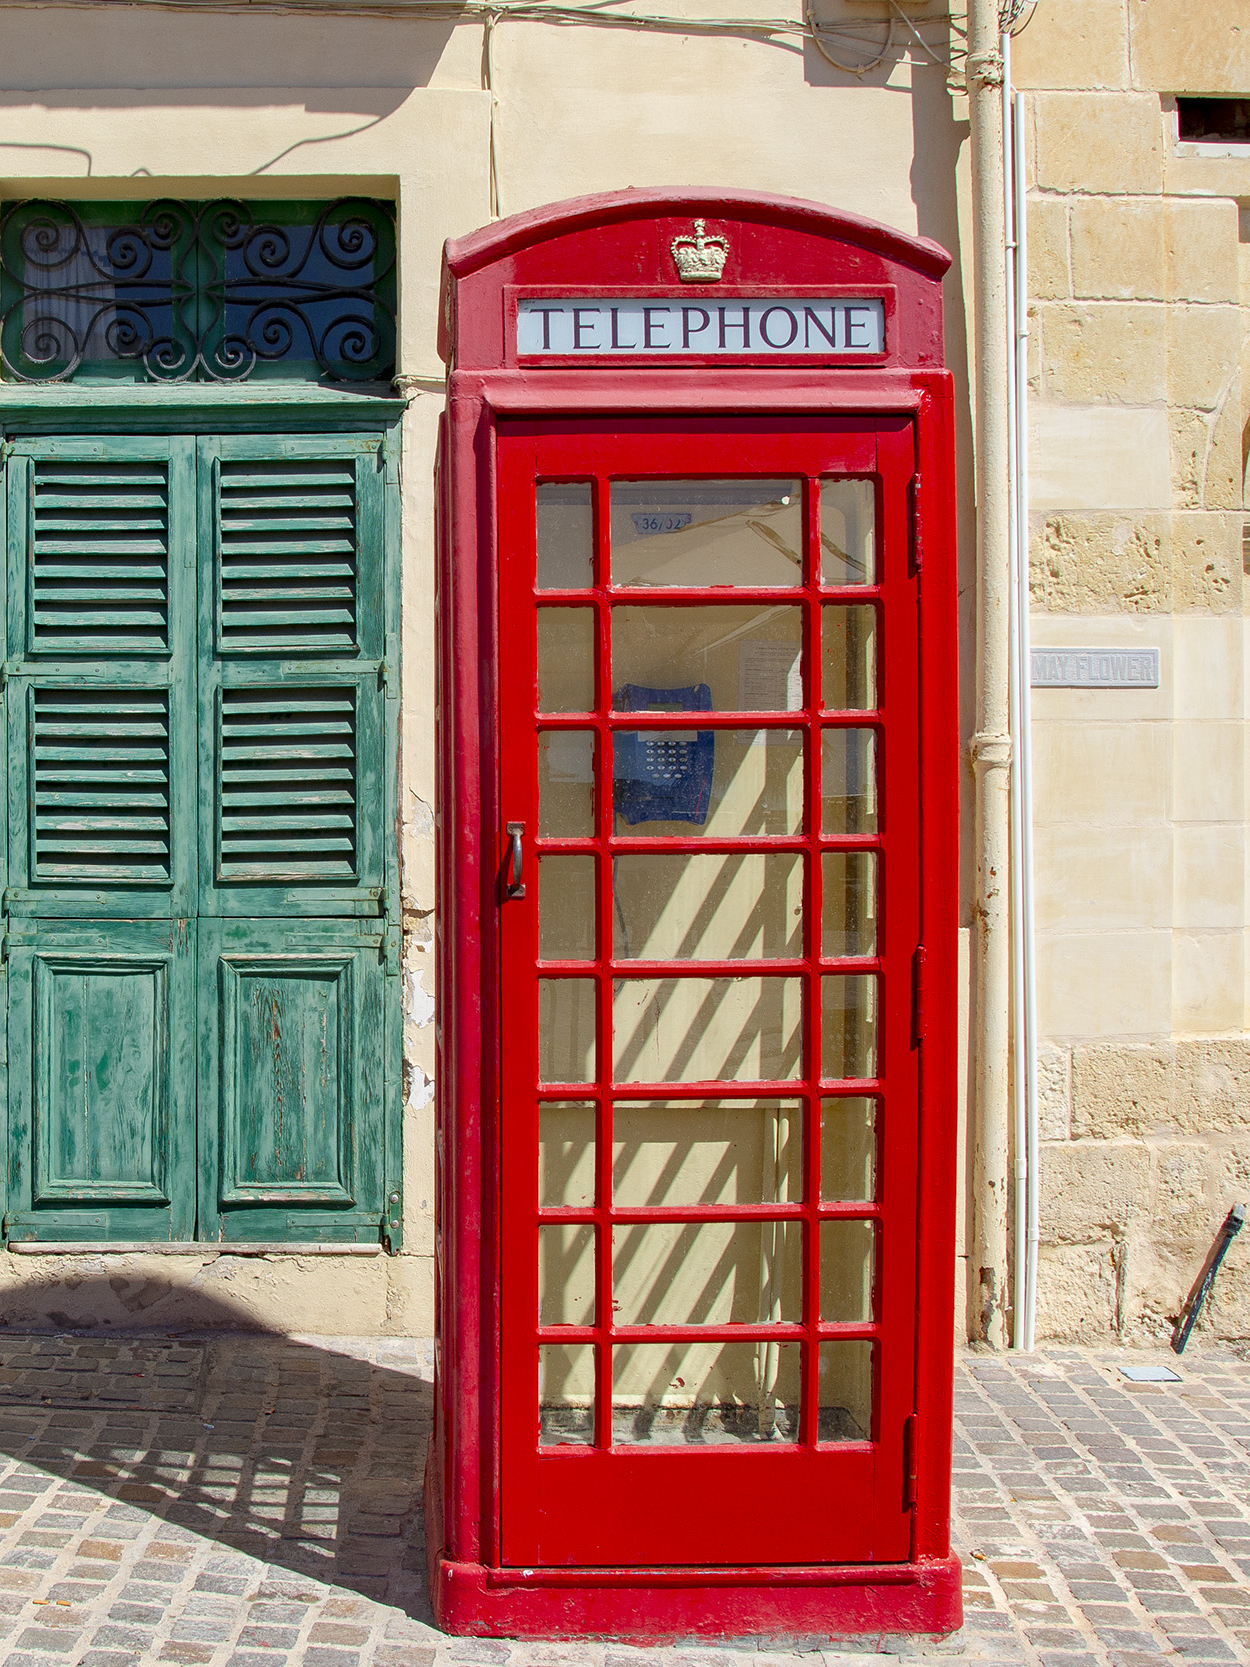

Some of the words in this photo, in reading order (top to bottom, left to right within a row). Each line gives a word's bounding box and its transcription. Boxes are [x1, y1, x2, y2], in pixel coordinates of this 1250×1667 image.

[528, 305, 873, 350] TELEPHONE
[1032, 655, 1068, 681] MAY
[1076, 655, 1154, 681] FLOWER
